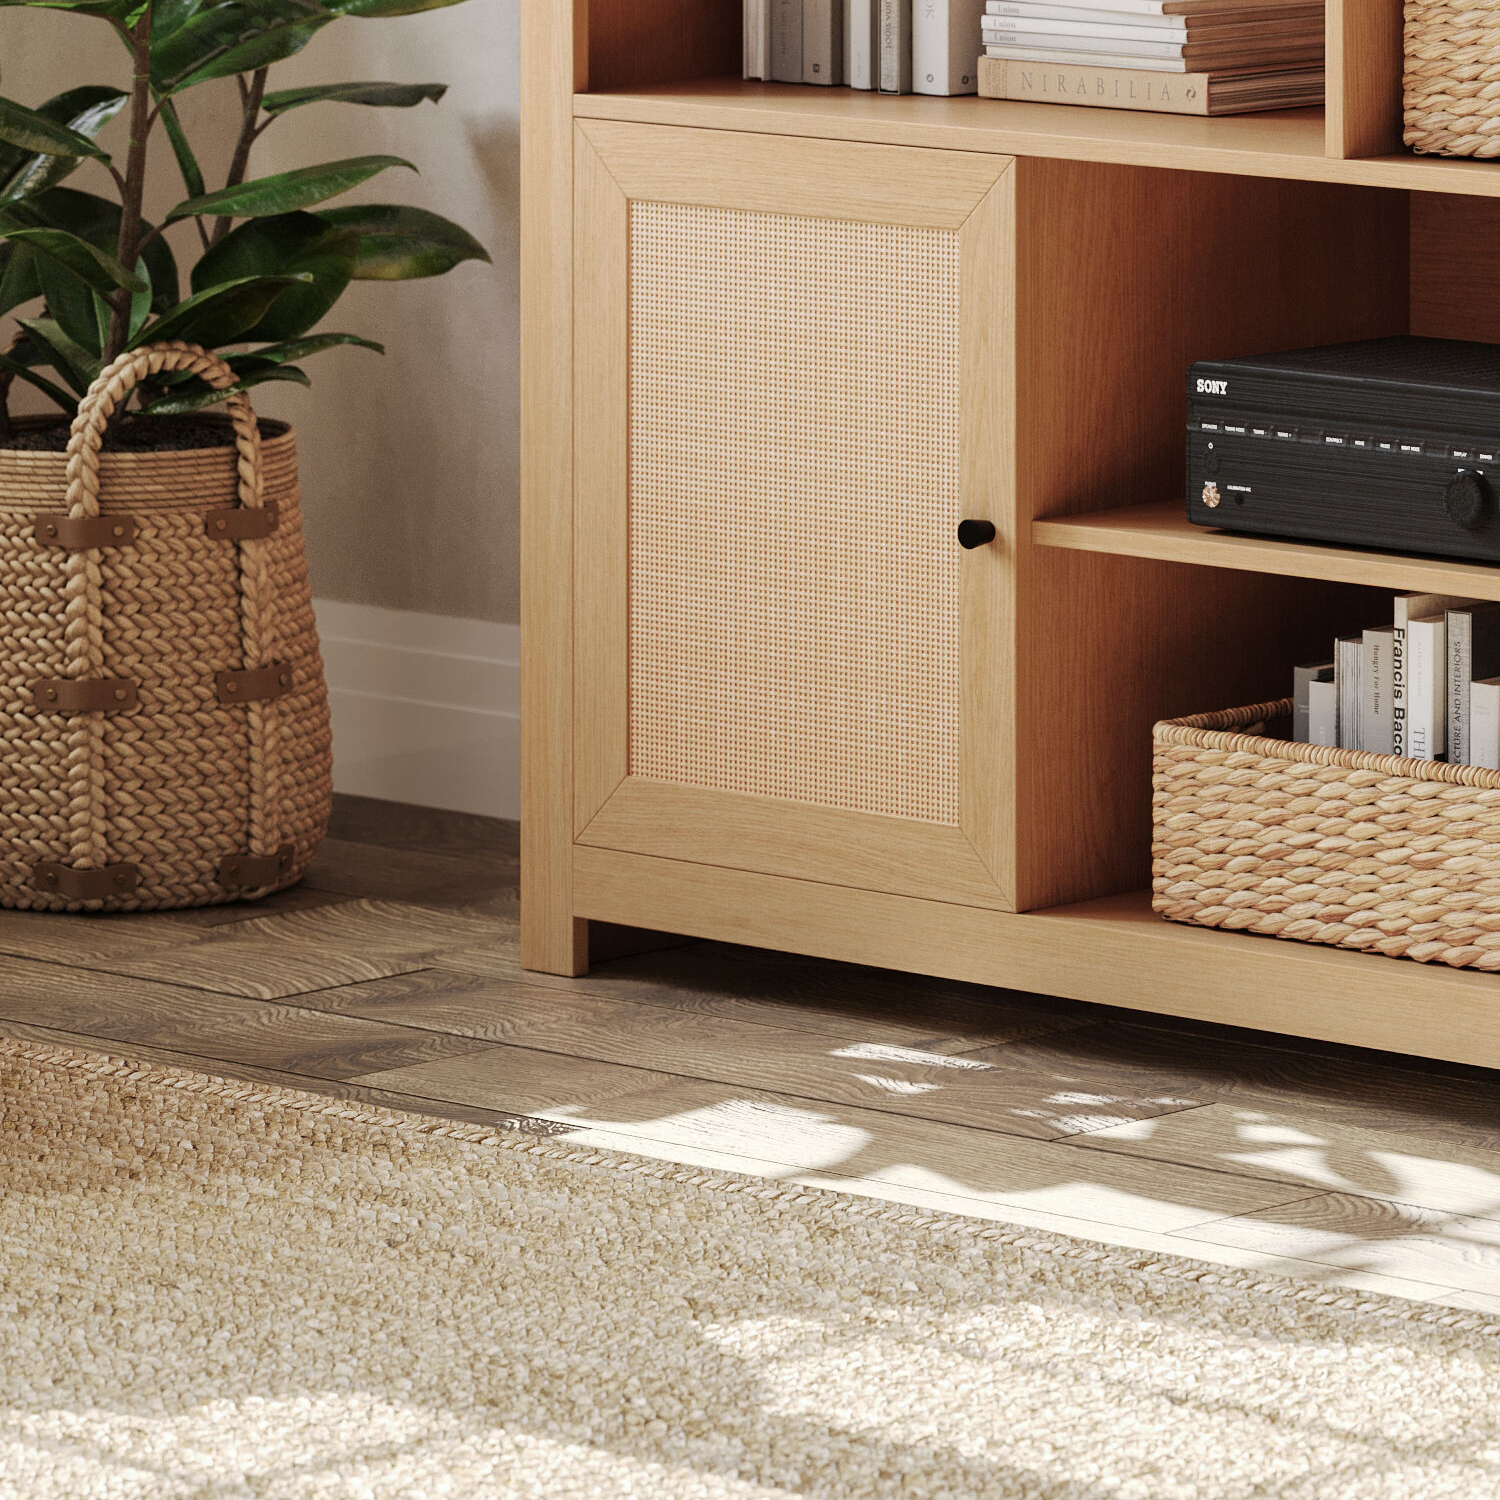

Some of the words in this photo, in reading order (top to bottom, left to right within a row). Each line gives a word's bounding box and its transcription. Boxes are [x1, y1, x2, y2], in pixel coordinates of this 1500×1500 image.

[1021, 72, 1171, 101] NIRABILIA
[1196, 378, 1228, 395] SONY
[1394, 626, 1405, 700] Francis
[1453, 641, 1461, 696] INTERIORS
[1453, 699, 1461, 723] AND
